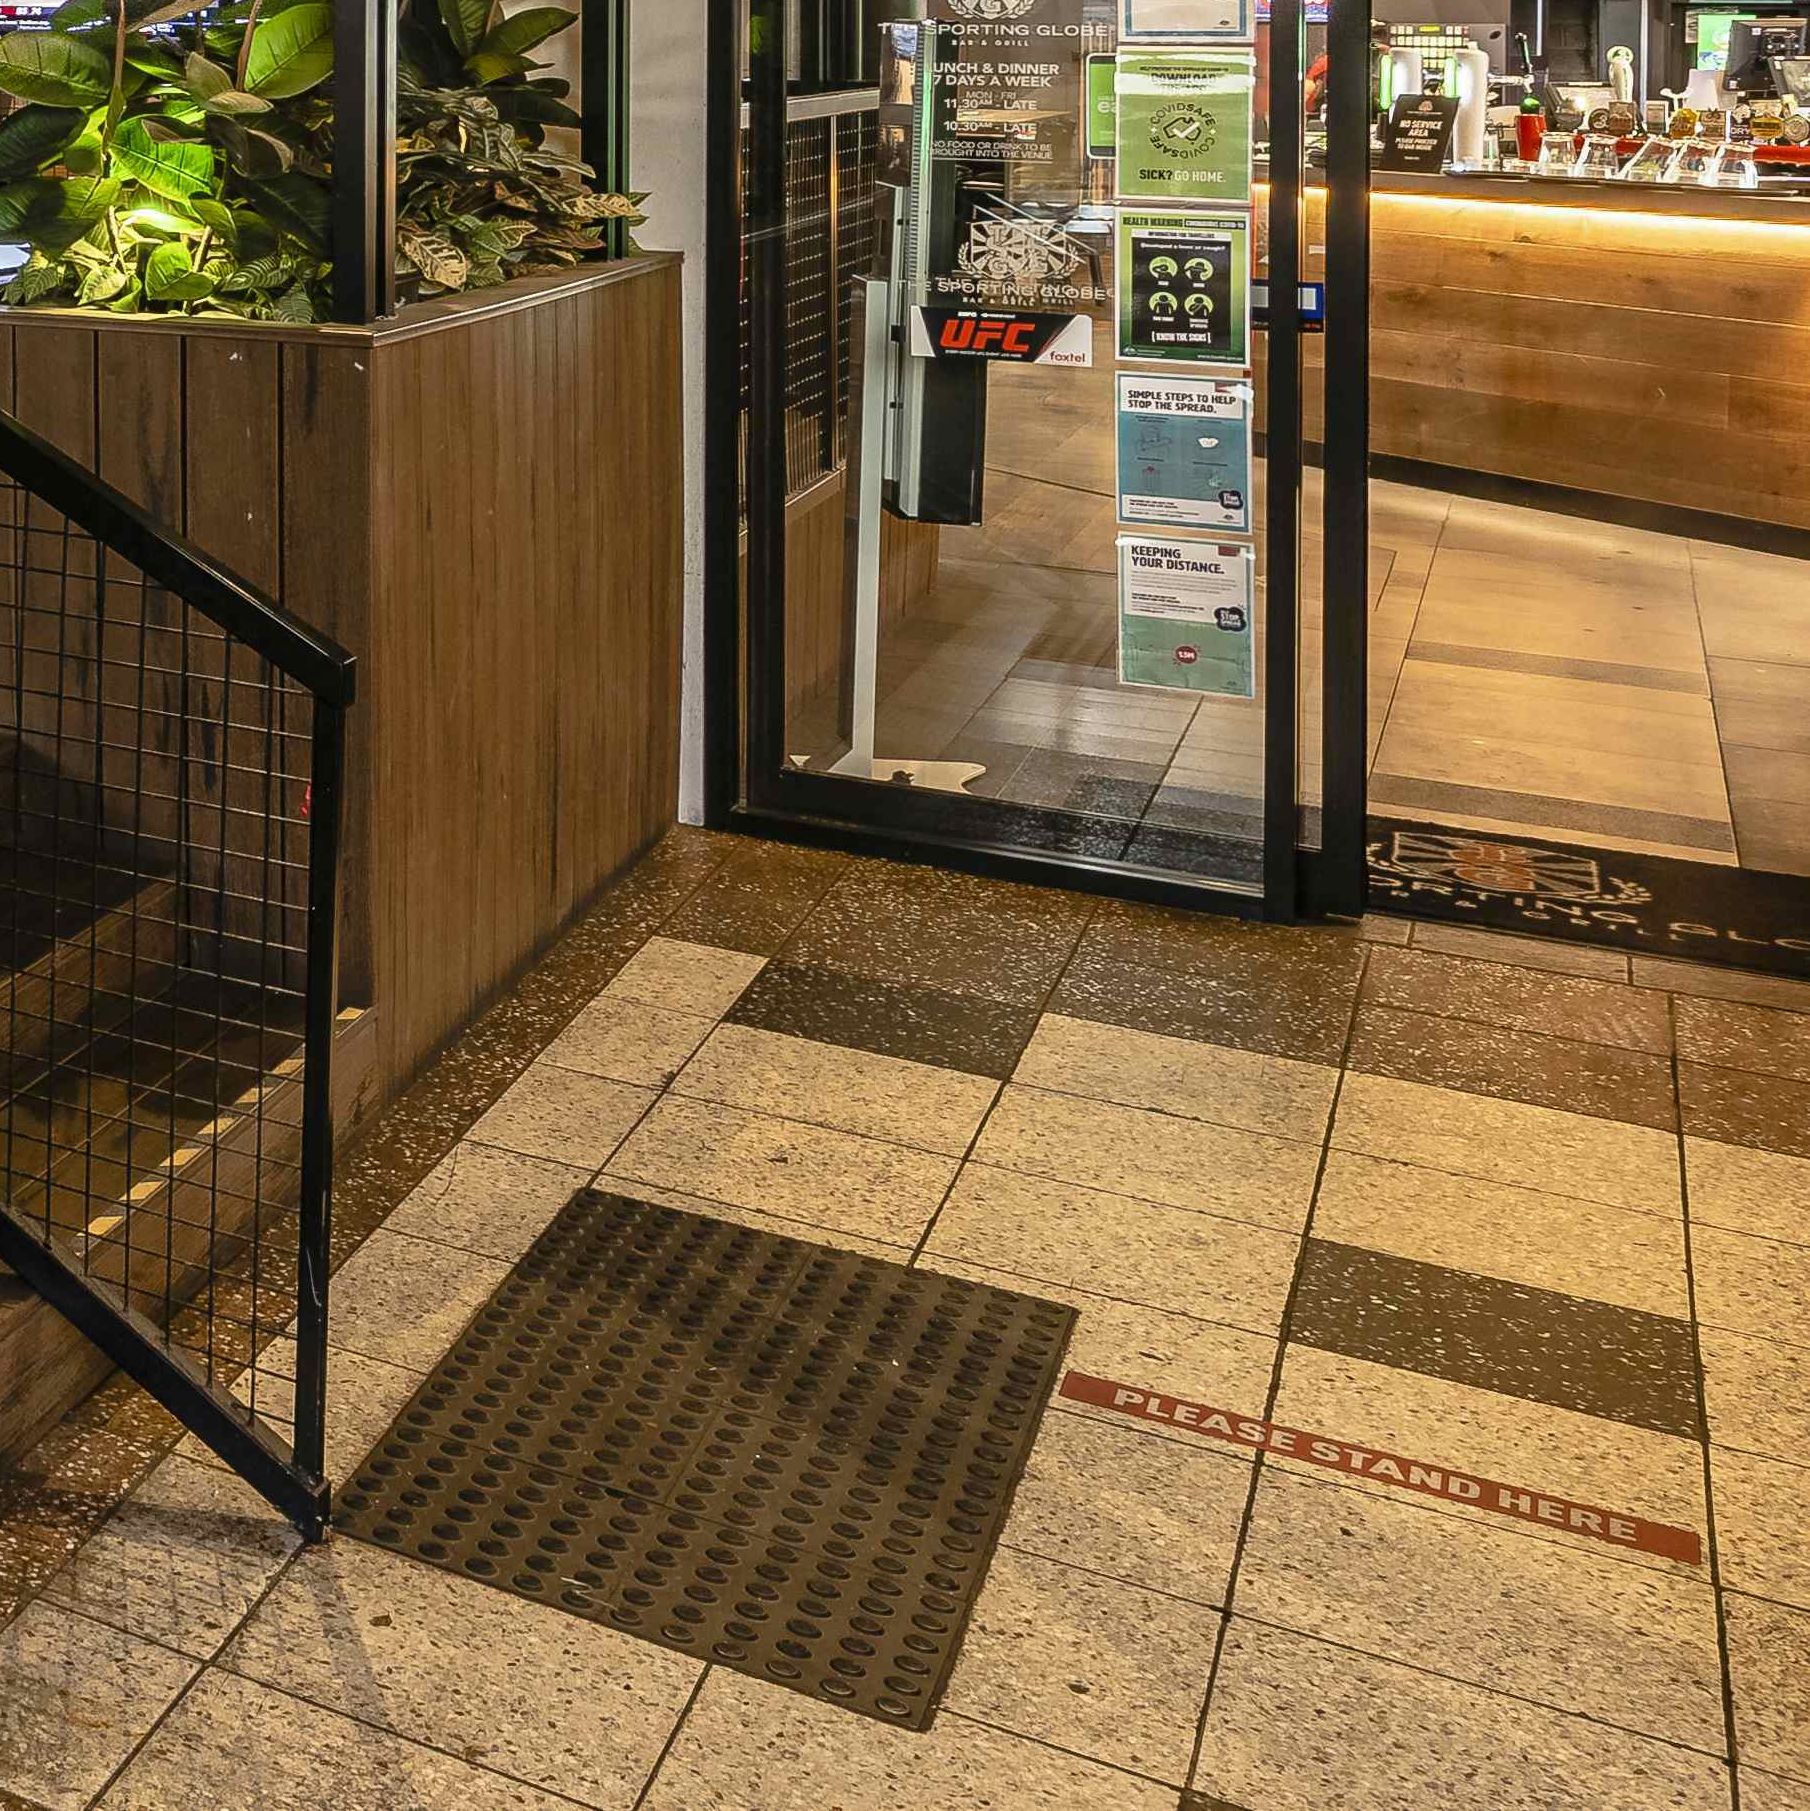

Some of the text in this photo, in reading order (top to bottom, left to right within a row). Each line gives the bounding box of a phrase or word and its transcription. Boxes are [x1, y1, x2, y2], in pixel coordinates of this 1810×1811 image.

[928, 23, 1030, 37] SPORTING
[1036, 24, 1109, 38] GLOBE
[982, 63, 995, 74] &
[998, 63, 1060, 76] DINNER
[945, 75, 985, 87] DAYS
[988, 76, 1001, 87] A
[1005, 76, 1052, 88] WEEK
[966, 91, 993, 100] MON
[1003, 100, 1038, 111] LATE
[1150, 102, 1217, 126] COVIDSAFE
[1003, 122, 1038, 133] LATE
[1399, 120, 1443, 130] NO SERVICE
[1730, 127, 1750, 135] DRY
[1408, 129, 1429, 137] AREA
[948, 140, 976, 149] FOOD
[977, 141, 992, 150] OR
[1150, 135, 1216, 159] COVIDSAFE
[976, 150, 1000, 158] INTO
[1021, 151, 1053, 159] VENUE
[1139, 169, 1227, 183] SICK? GO HOME.
[939, 319, 1036, 352] UFC
[1050, 350, 1086, 363] foxtel
[1128, 390, 1237, 405] SIMPLE STEPS TO HELP
[1128, 399, 1217, 414] STOP THE SPREAD.
[1131, 545, 1182, 559] KEEPING
[1131, 556, 1226, 575] YOUR DISTANCE.
[1114, 1388, 1637, 1542] PLEASE STAND HERE
